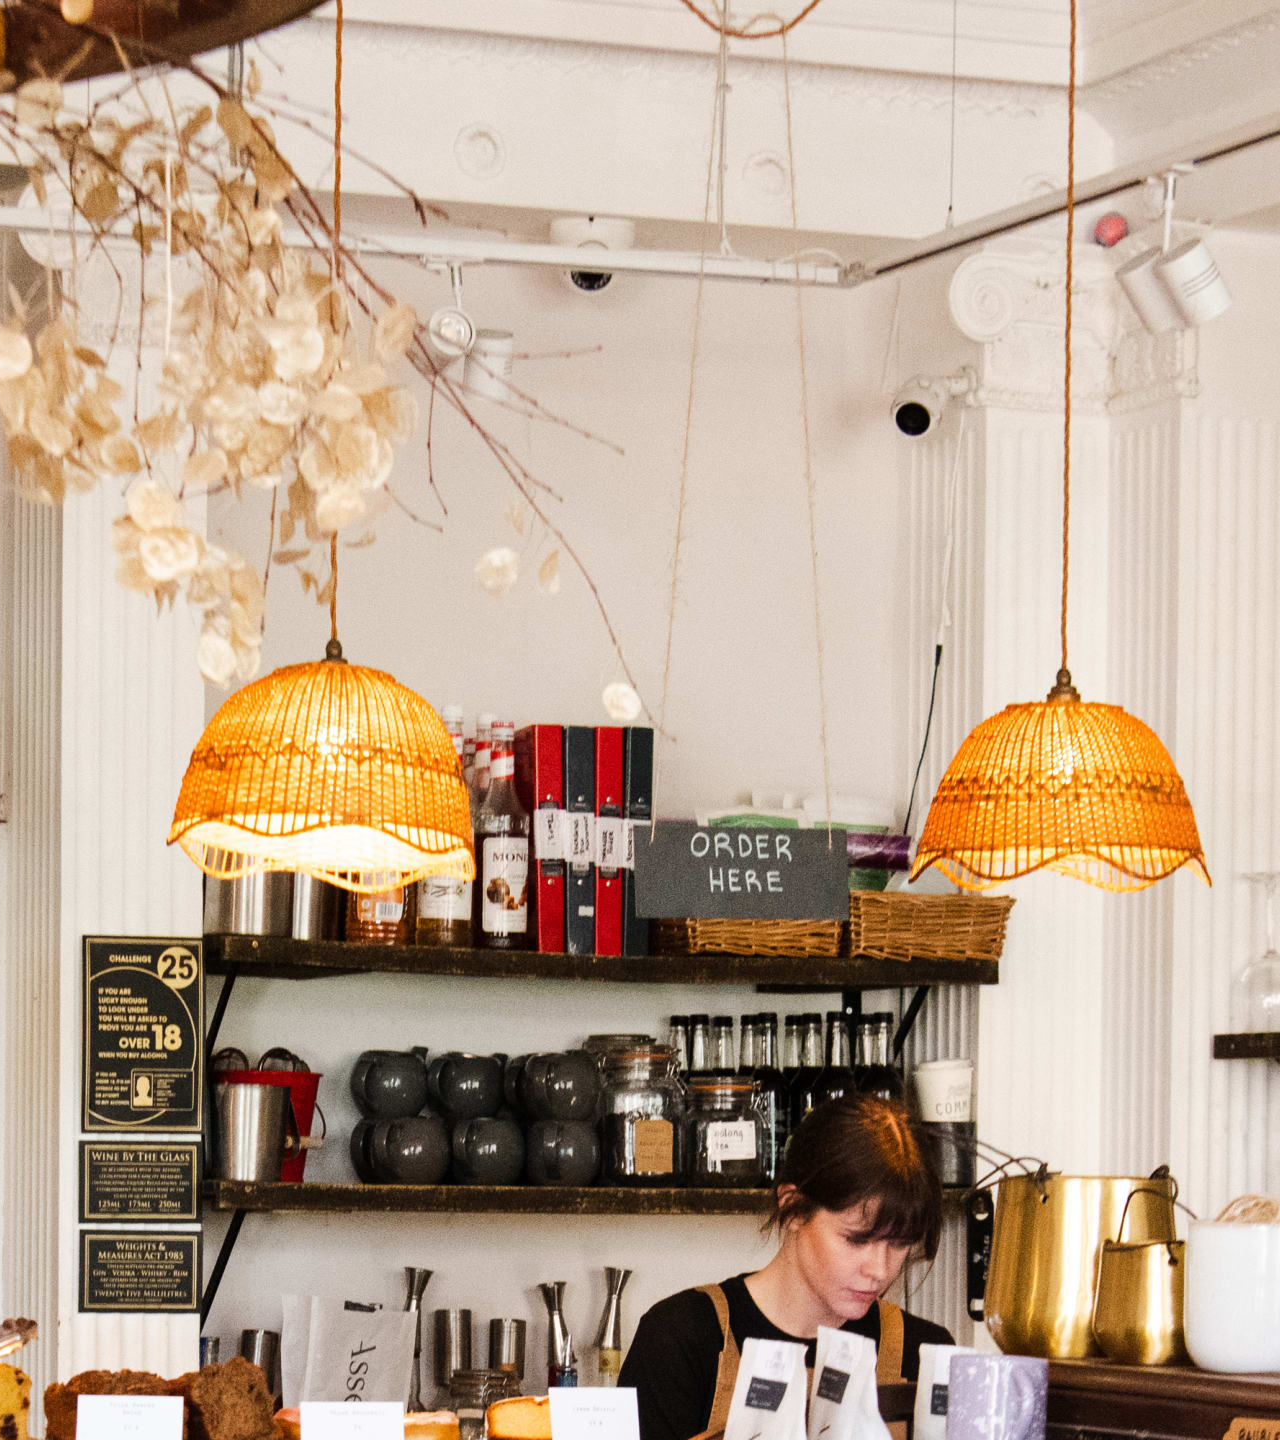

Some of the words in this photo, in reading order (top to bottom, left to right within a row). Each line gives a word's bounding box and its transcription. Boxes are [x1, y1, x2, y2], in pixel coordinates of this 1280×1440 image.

[689, 831, 793, 863] ORDER
[709, 867, 784, 893] HERE
[109, 954, 152, 964] CHALLENGE
[161, 953, 194, 980] 25
[98, 987, 104, 995] IF
[105, 987, 118, 995] YOU
[119, 987, 131, 995] ARE
[127, 1006, 148, 1014] UNDER
[137, 1015, 158, 1023] ASKED
[159, 1015, 167, 1023] TO
[118, 1037, 150, 1049] OVER
[151, 1023, 182, 1051] 18
